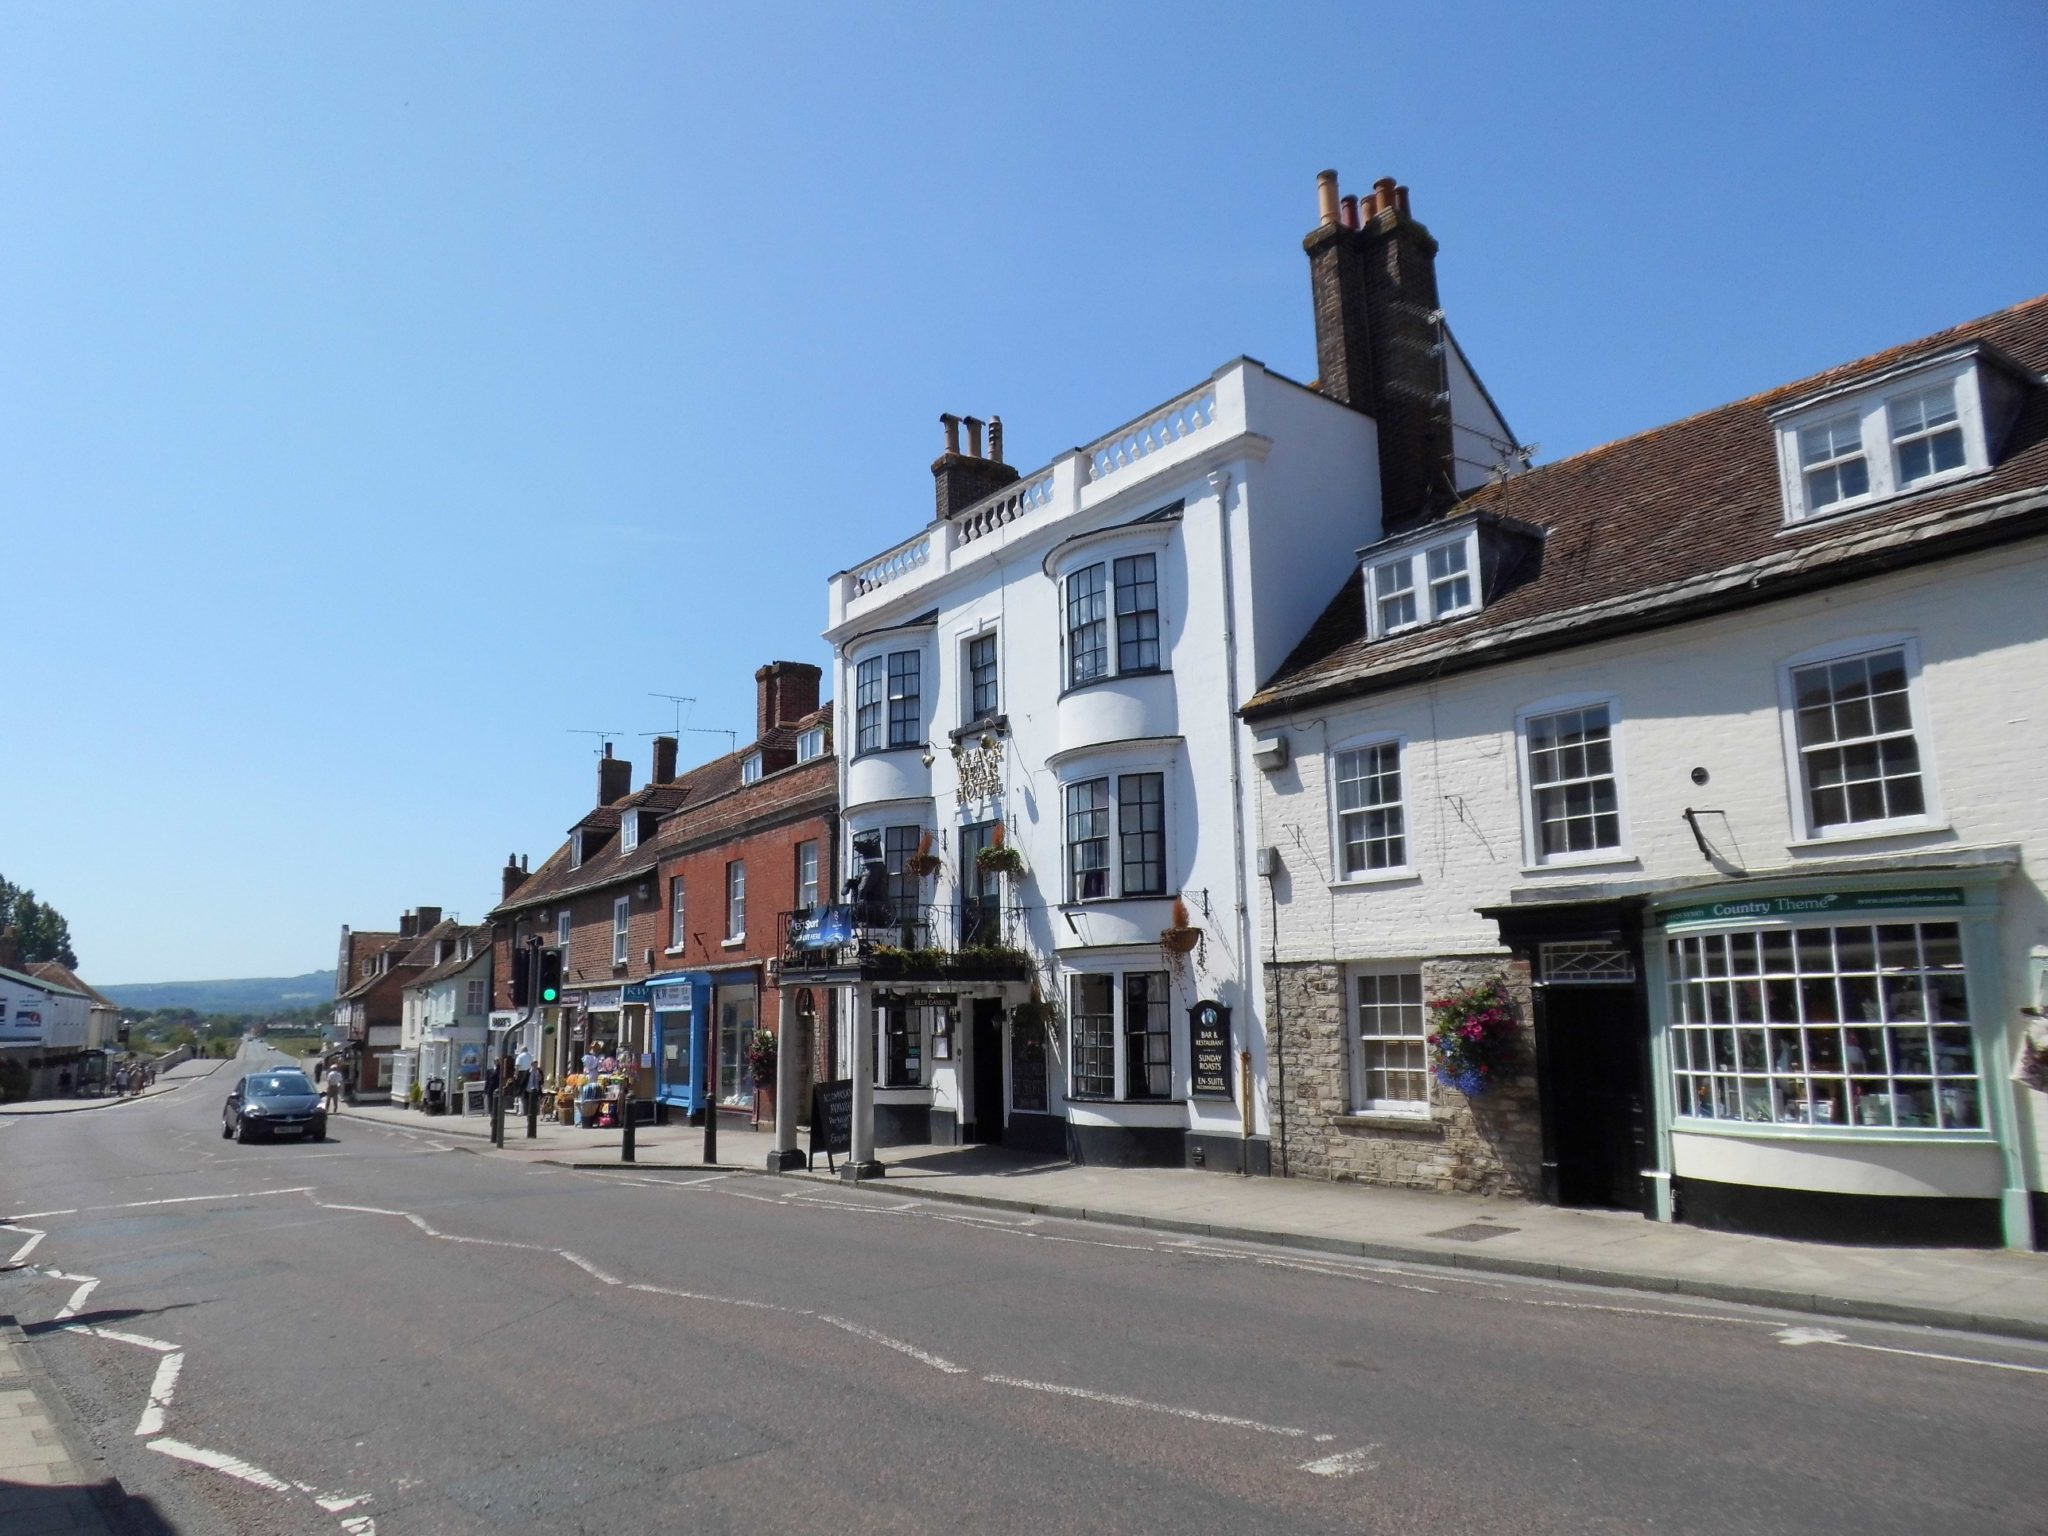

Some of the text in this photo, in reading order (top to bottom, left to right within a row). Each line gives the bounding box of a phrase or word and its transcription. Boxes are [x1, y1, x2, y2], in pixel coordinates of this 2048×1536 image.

[959, 761, 998, 785] BEAR
[955, 778, 1003, 804] HOTEL
[1713, 902, 1770, 916] Country
[1776, 898, 1828, 911] Theme
[805, 919, 819, 930] Sport
[1201, 1031, 1218, 1039] BAR &
[1198, 1054, 1222, 1062] SUNDAY
[1199, 1062, 1222, 1071] ROASTS
[1197, 1077, 1224, 1086] EN-SUITE
